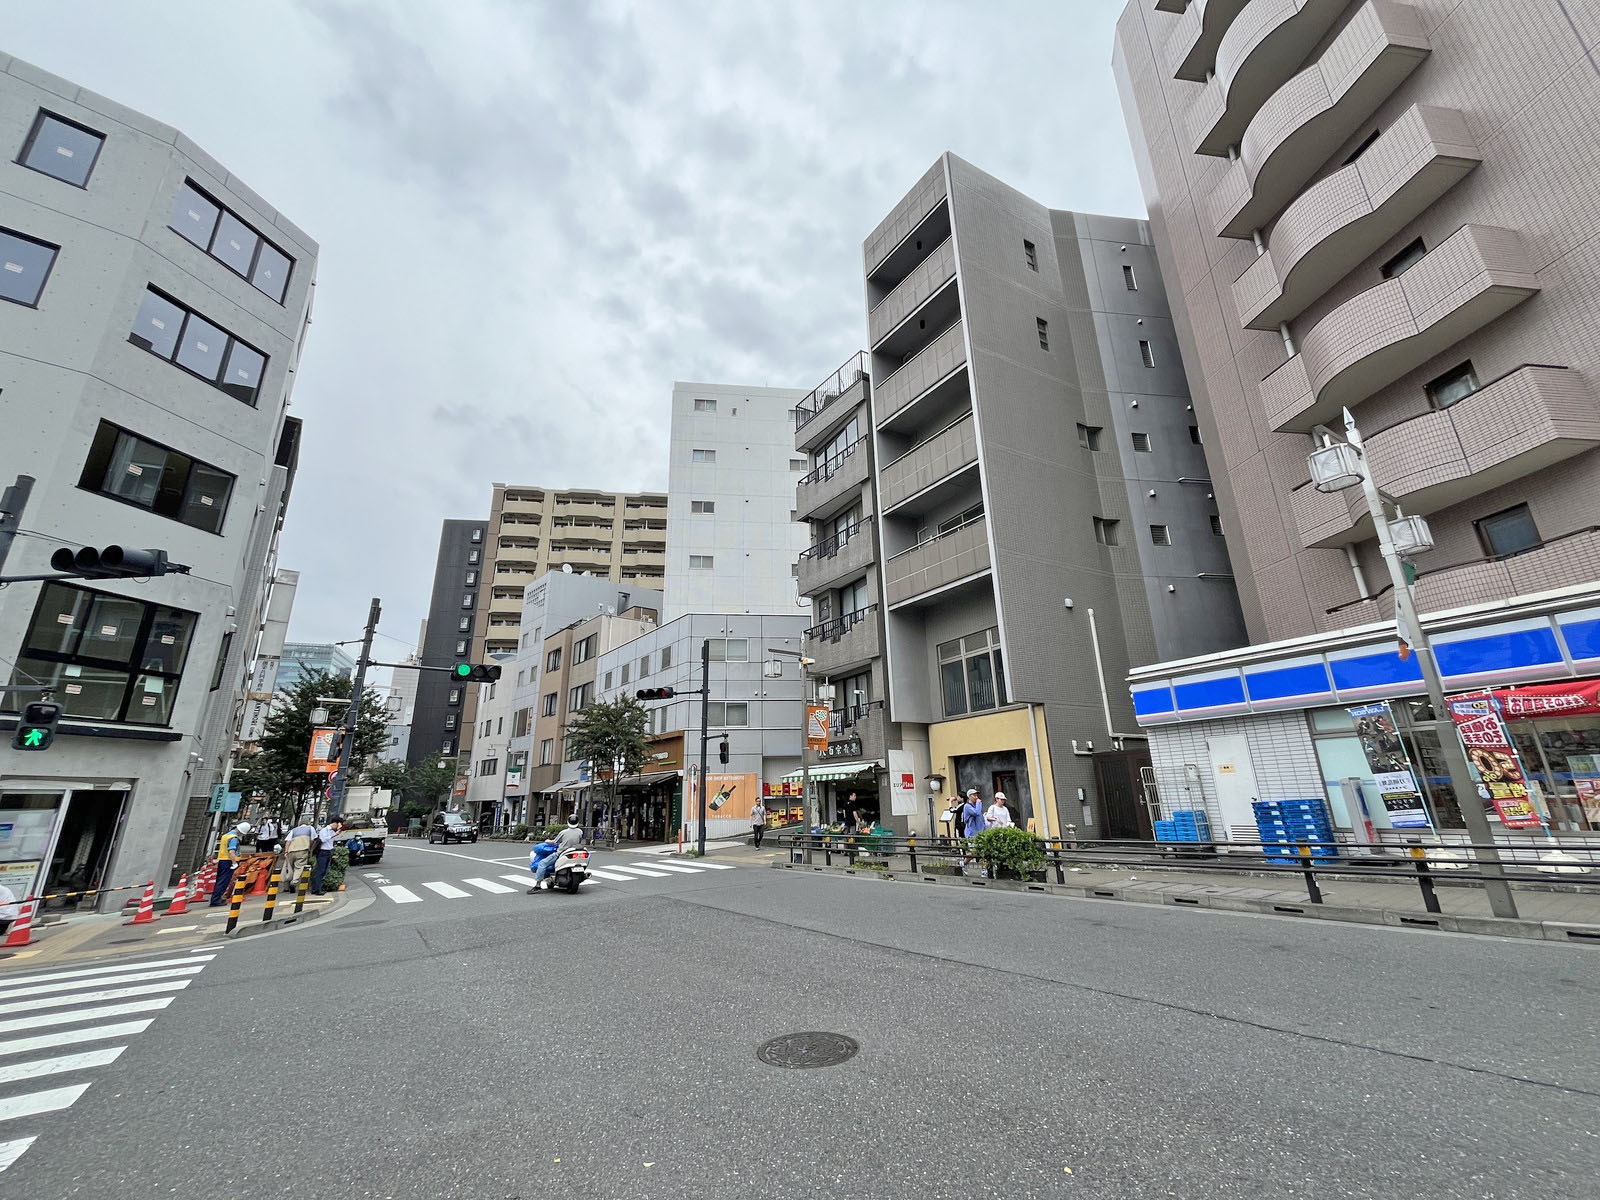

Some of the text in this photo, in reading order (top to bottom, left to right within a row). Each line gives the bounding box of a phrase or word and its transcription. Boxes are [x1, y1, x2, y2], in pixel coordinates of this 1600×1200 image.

[1511, 695, 1583, 712] お値段そのまま
